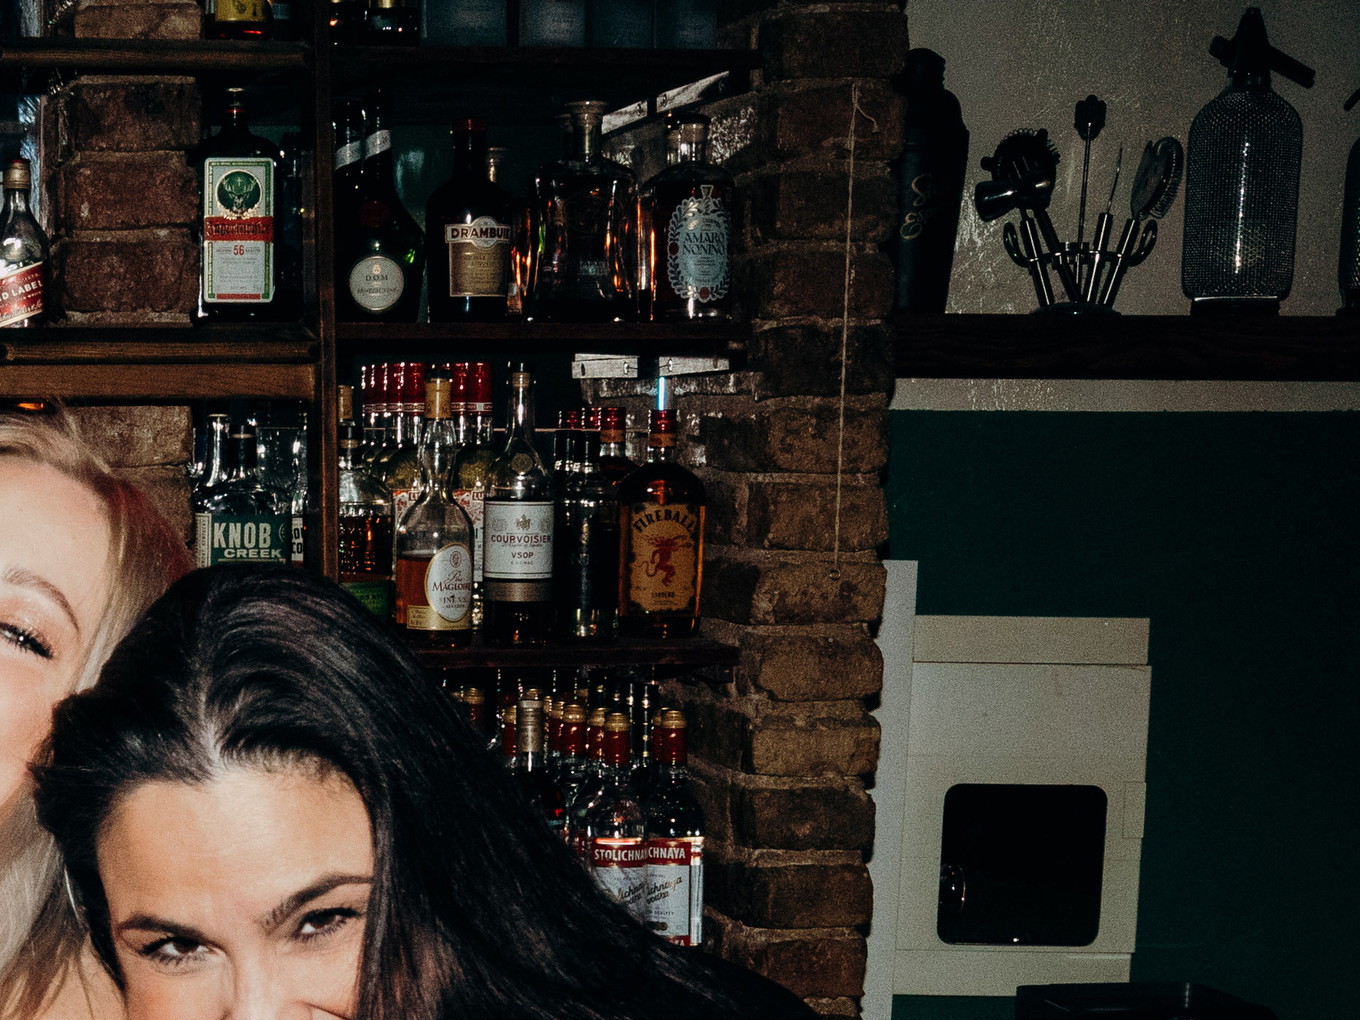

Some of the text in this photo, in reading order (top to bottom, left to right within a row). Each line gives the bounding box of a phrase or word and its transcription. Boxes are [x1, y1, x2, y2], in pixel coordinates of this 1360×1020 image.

[233, 244, 245, 256] 56
[11, 280, 44, 297] LABEL
[633, 508, 695, 533] FIREBALL
[213, 521, 272, 549] KNOB
[490, 534, 551, 544] COURVOISIER
[223, 548, 283, 558] CREEK
[511, 551, 534, 559] VSOP
